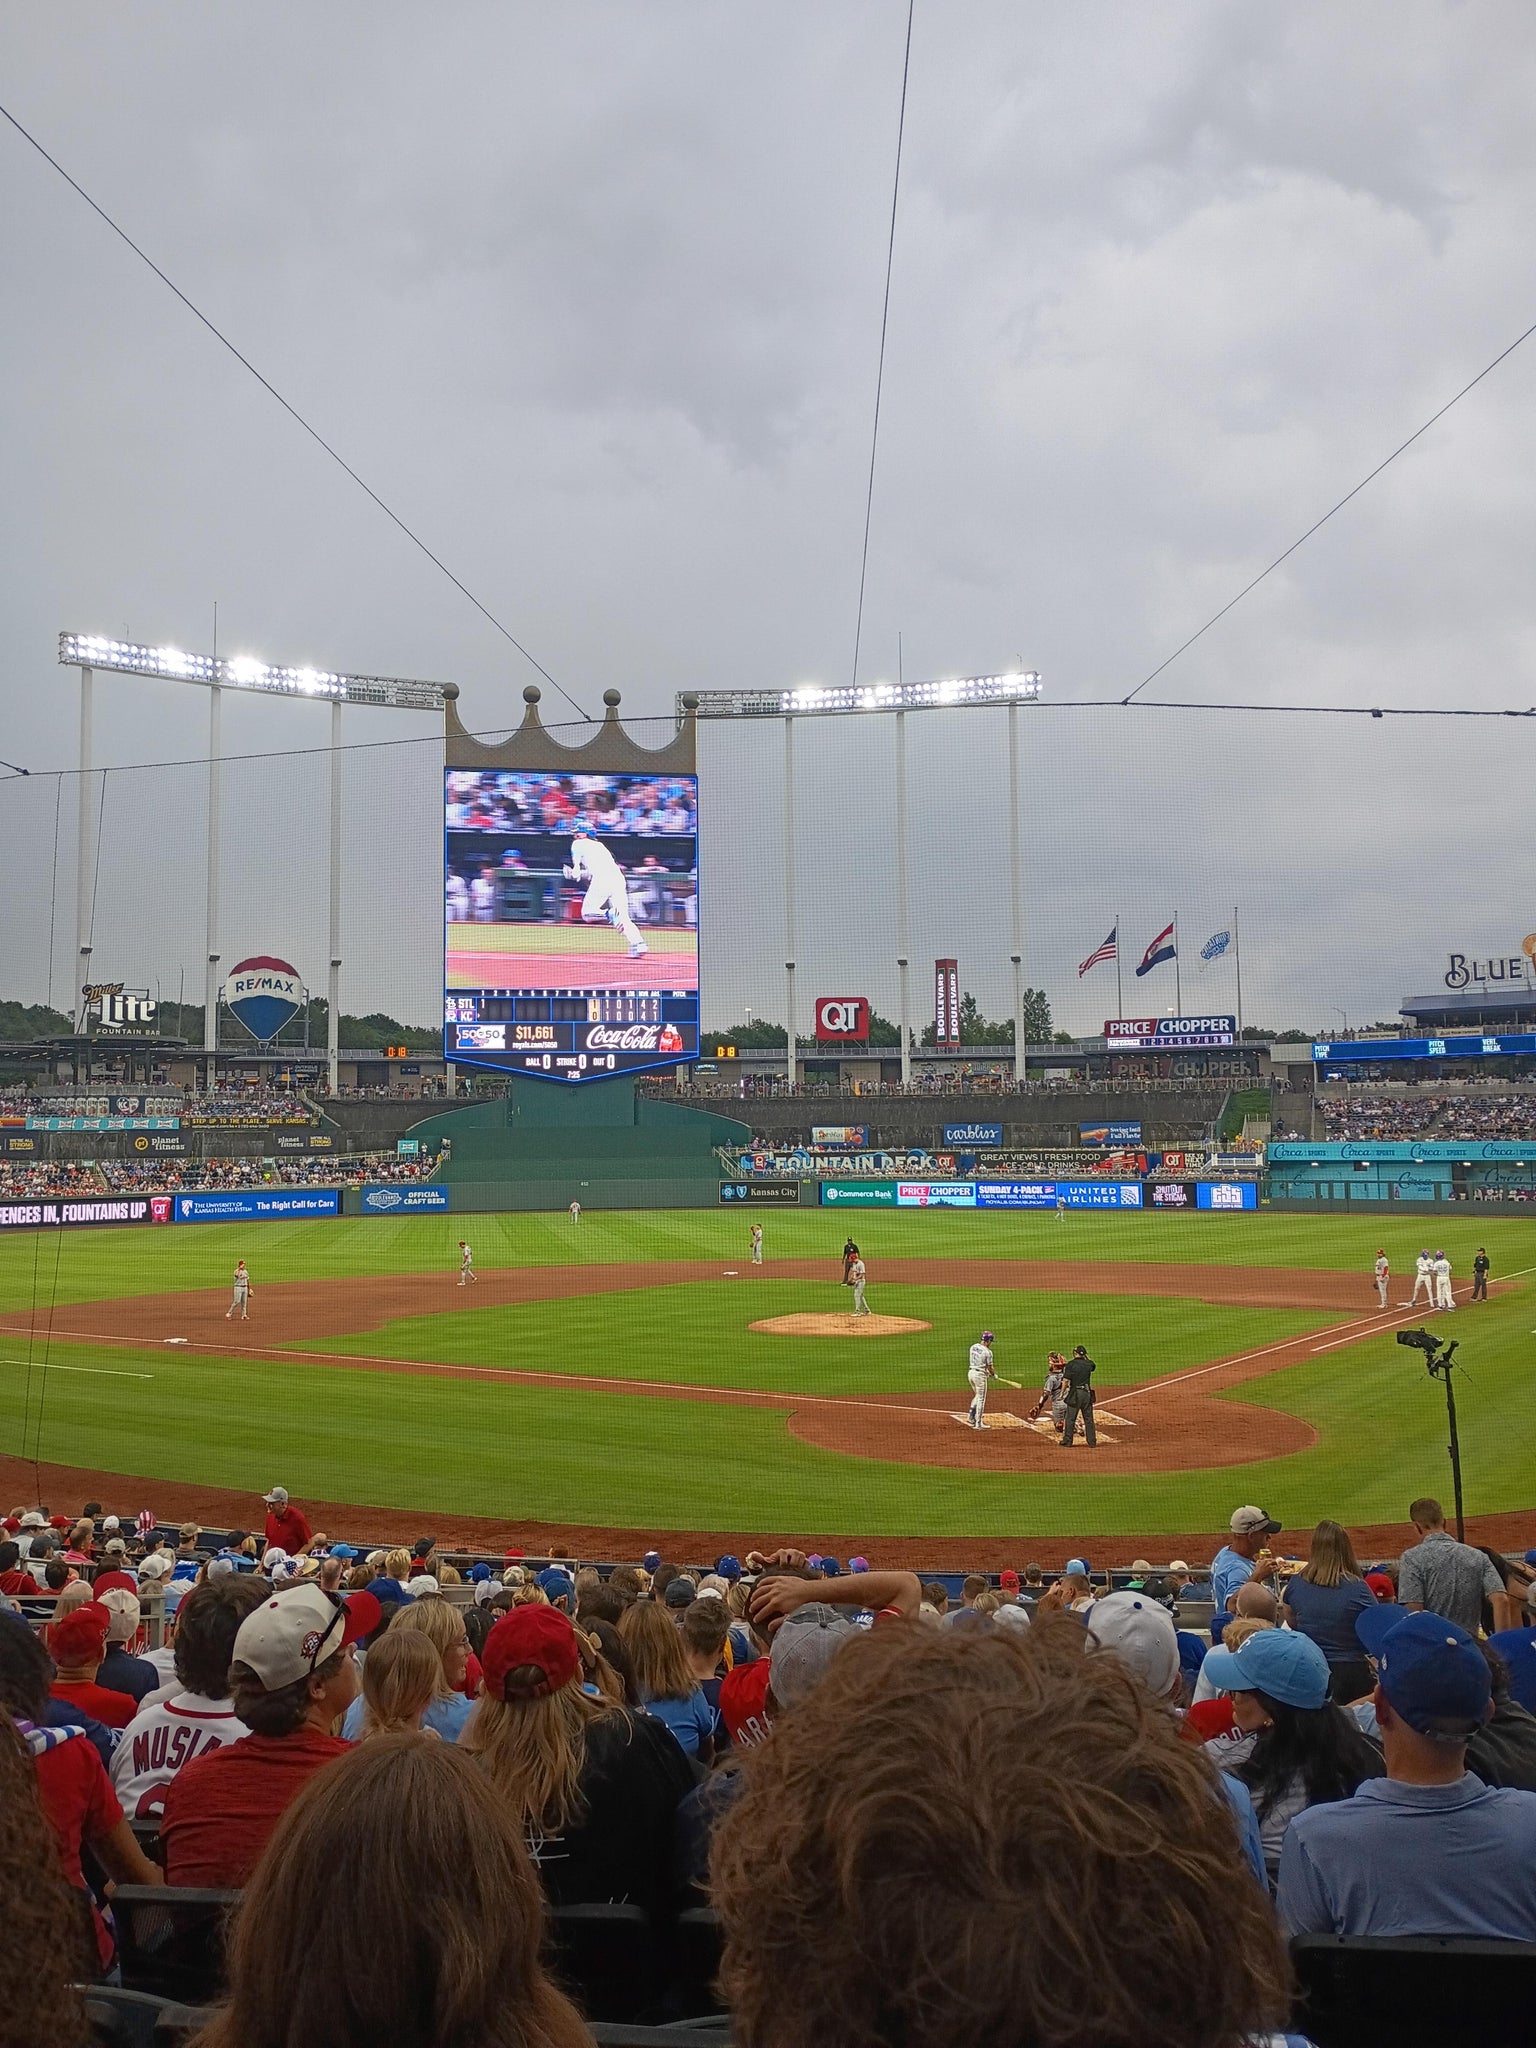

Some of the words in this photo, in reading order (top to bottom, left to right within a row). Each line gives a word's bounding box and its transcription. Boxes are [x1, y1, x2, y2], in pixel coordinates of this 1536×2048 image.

[1444, 954, 1522, 989] BLUE
[82, 982, 125, 1004] Miller
[235, 978, 294, 994] RE/MAX
[98, 994, 157, 1028] Lite
[458, 998, 474, 1009] STL
[616, 1000, 621, 1009] 0
[641, 1000, 646, 1009] 4
[653, 1000, 658, 1009] 2
[937, 973, 946, 1036] BOULEVARD
[950, 973, 959, 1036] BOULEVARD
[460, 1011, 472, 1021] KC
[616, 1012, 621, 1021] 0
[629, 1012, 633, 1021] 0
[641, 1012, 646, 1021] 4
[822, 1002, 860, 1032] QT
[516, 1026, 554, 1040] $11,661
[1110, 1022, 1151, 1035] PRICE
[1160, 1018, 1230, 1034] CHOPPER
[388, 1047, 406, 1057] 0:18
[718, 1047, 736, 1057] 0:18
[526, 1058, 541, 1066] BALL
[543, 1054, 550, 1069] 0
[556, 1058, 576, 1066] STRIKE
[579, 1054, 586, 1069] 0
[593, 1058, 605, 1066] OUT
[607, 1054, 615, 1069] 0
[946, 1125, 998, 1141] carbliss
[152, 1137, 179, 1147] planet
[1274, 1143, 1303, 1159] Circa
[1341, 1143, 1372, 1159] Circa
[1410, 1143, 1441, 1159] Circa
[1482, 1143, 1515, 1158] Circa
[776, 1156, 873, 1170] FOUNTAIN
[882, 1156, 935, 1170] DECK
[938, 1157, 951, 1167] QT
[1166, 1154, 1180, 1166] QT
[751, 1188, 779, 1196] Kansas
[781, 1188, 797, 1197] City
[0, 1206, 41, 1224] ENCES
[43, 1206, 60, 1224] IN,
[62, 1202, 128, 1222] FOUNTAINS
[130, 1202, 146, 1219] UP
[154, 1204, 166, 1214] QT
[257, 1202, 270, 1210] The
[272, 1201, 290, 1211] Right
[292, 1200, 306, 1208] Call
[307, 1200, 317, 1208] for
[318, 1200, 334, 1208] Care
